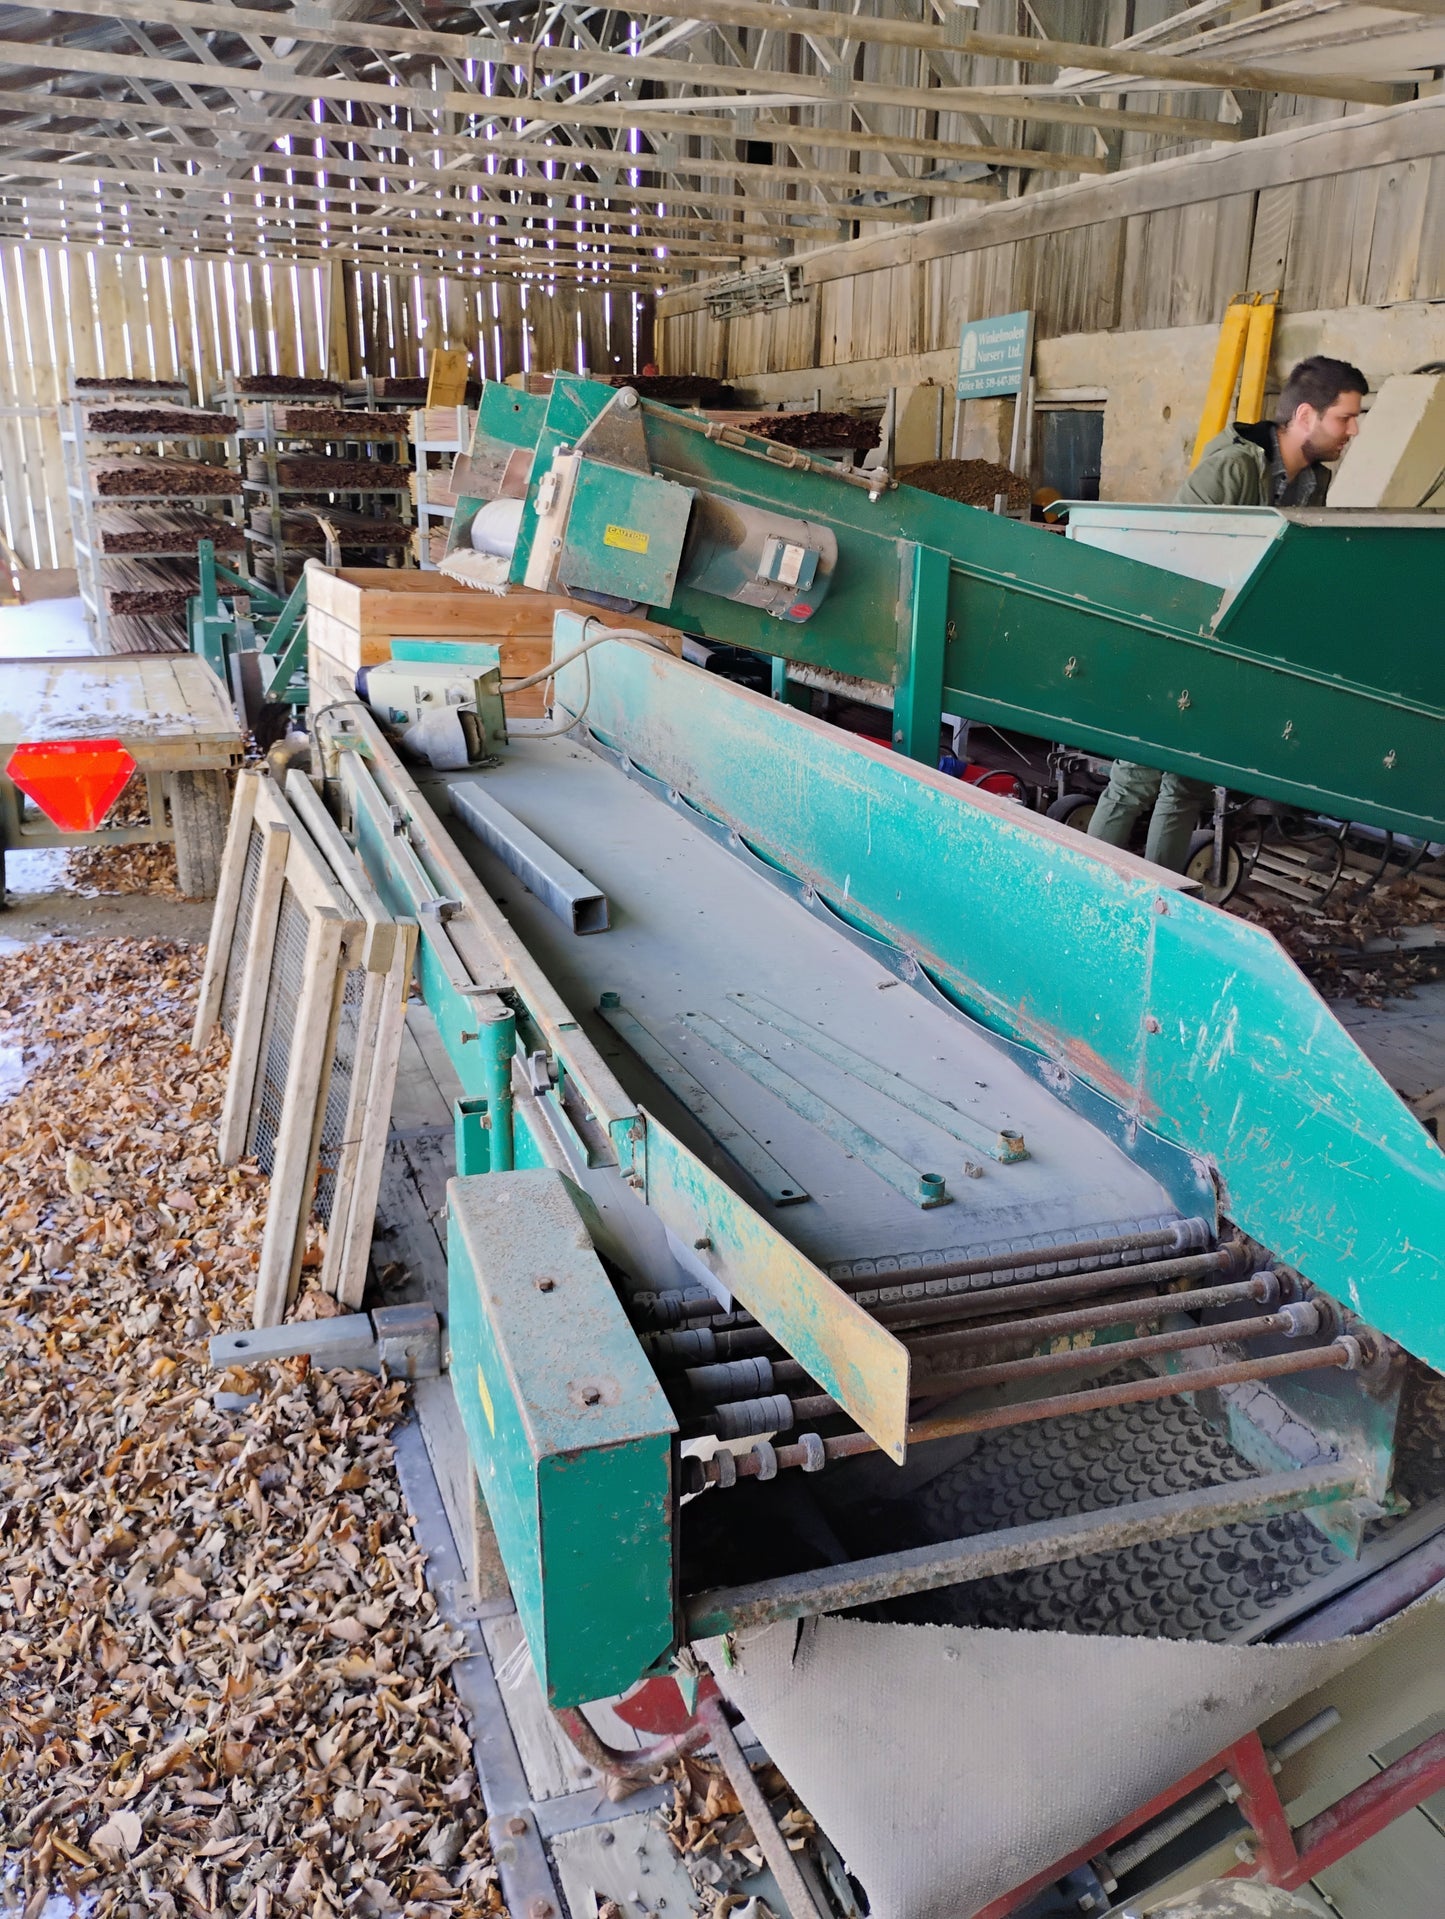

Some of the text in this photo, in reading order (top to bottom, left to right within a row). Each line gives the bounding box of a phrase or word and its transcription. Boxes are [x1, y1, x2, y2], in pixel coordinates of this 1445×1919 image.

[979, 326, 1024, 345] Winkelmolen
[978, 343, 1022, 363] Nursery Ltd.
[958, 380, 974, 392] Office
[608, 526, 648, 541] CAUTION
